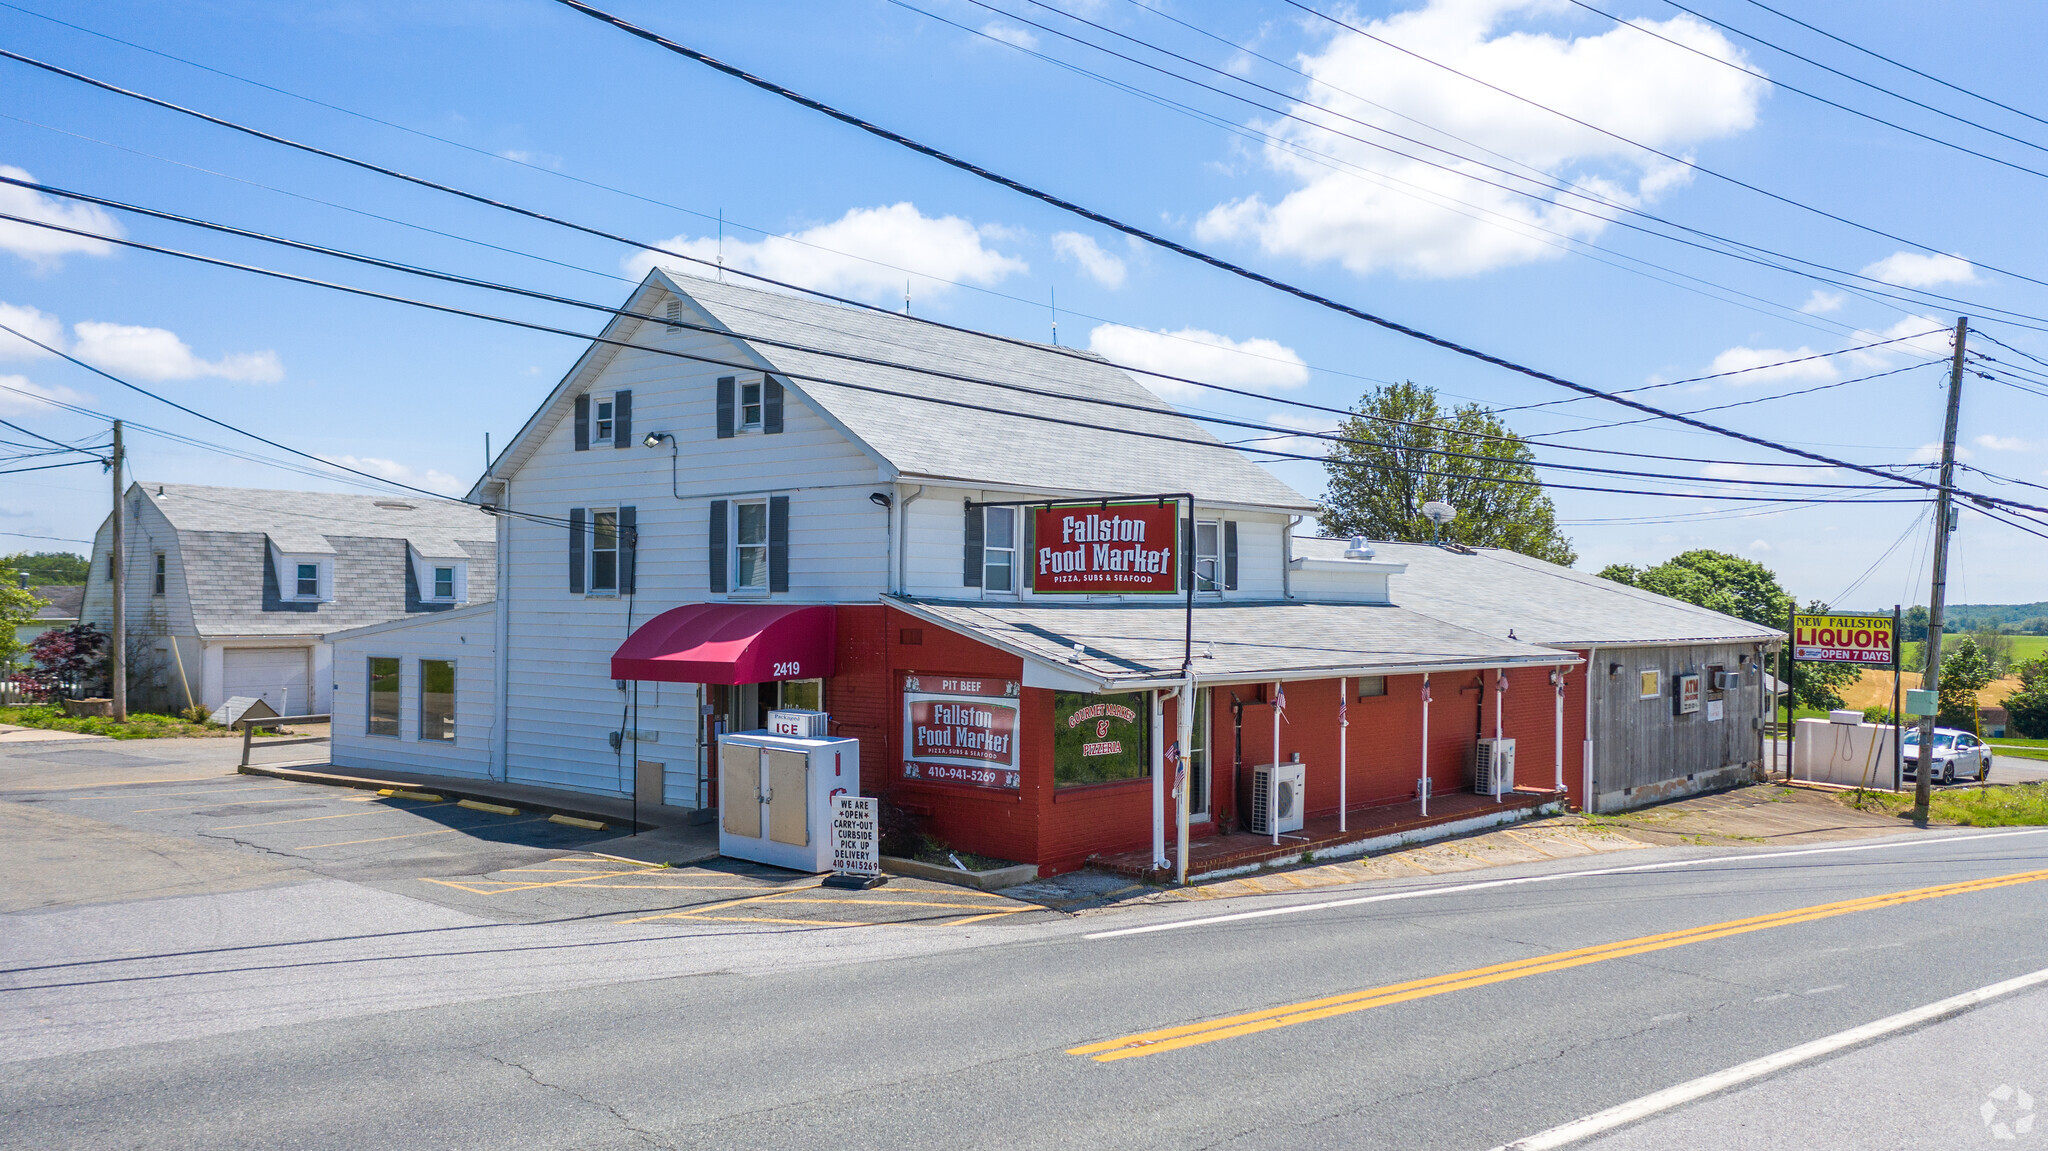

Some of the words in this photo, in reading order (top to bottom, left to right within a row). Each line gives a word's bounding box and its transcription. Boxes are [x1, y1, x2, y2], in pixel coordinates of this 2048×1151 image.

[1062, 514, 1146, 544] Fallston
[1039, 544, 1087, 575] Food
[1092, 543, 1171, 575] Market
[1054, 574, 1081, 583] PIZZA,
[1083, 574, 1103, 582] SUBS
[1113, 574, 1153, 583] SEAFOOD
[1796, 617, 1822, 627] NEW
[1829, 618, 1892, 629] FALLSTON
[1796, 628, 1890, 649] LIQUOR
[1821, 649, 1850, 660] OPEN
[1852, 651, 1860, 660] 7
[1862, 651, 1889, 661] DAYS
[773, 661, 800, 677] 2419
[942, 680, 957, 691] PIT
[960, 680, 982, 692] BEEF
[1685, 679, 1698, 694] ATM
[934, 704, 992, 729] Fallston
[1068, 703, 1105, 728] GOURMET
[1105, 703, 1136, 723] MARKET
[776, 723, 798, 735] ICE
[1096, 720, 1110, 738] &
[917, 726, 951, 746] Food
[955, 726, 1009, 754] Market
[970, 750, 997, 760] SEAFOOD
[1083, 741, 1122, 757] PIZZERIA
[928, 766, 996, 783] 410-941-5269
[841, 800, 852, 809] WE
[855, 801, 869, 809] ARE
[845, 810, 863, 819] OPEN
[833, 819, 873, 830] CARRY-OUT
[838, 830, 872, 840] CURBSIDE
[841, 840, 856, 849] PICK
[860, 841, 870, 850] UP
[835, 850, 870, 860] DELIVERY
[832, 859, 844, 869] 410
[846, 860, 878, 871] 9415269
